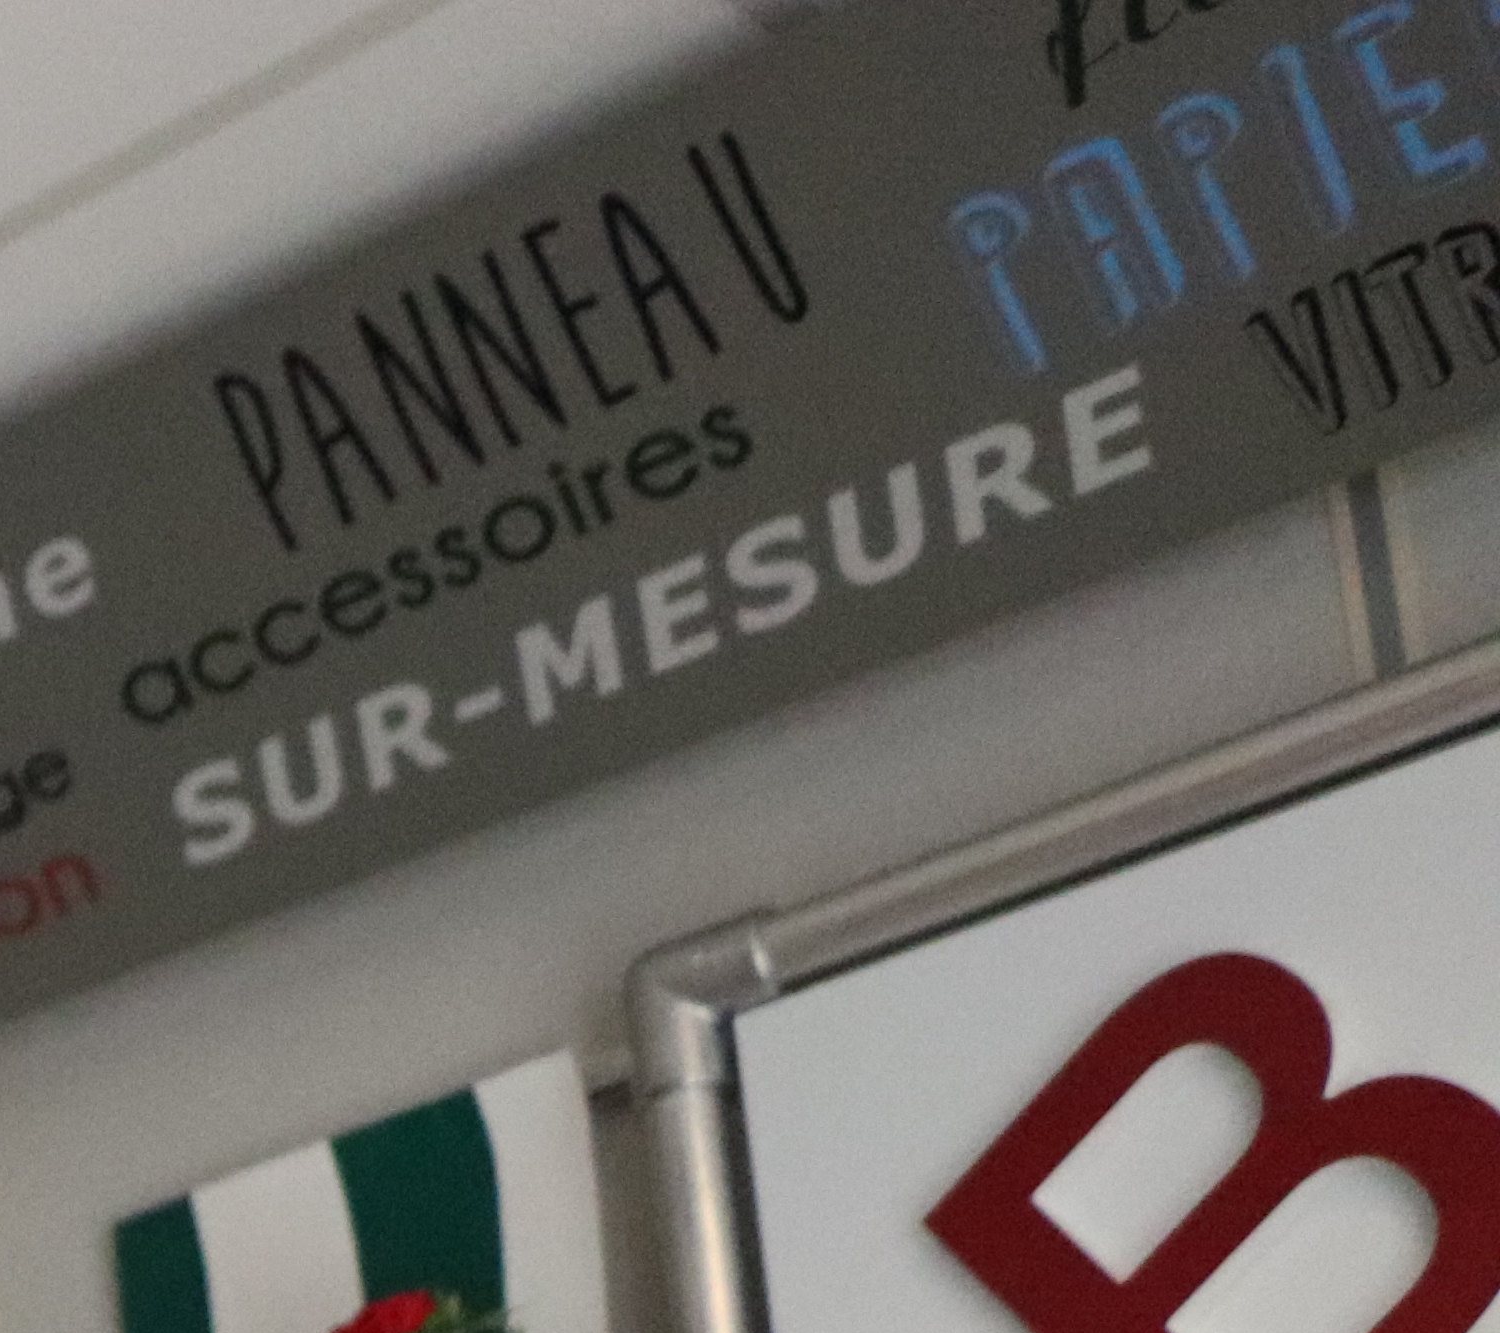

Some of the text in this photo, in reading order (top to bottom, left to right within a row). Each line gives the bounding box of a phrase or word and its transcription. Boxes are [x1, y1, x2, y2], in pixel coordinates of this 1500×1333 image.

[211, 131, 809, 553] PANNEAU
[950, 0, 1500, 374] PAPIE
[120, 403, 755, 725] accessoires
[171, 364, 1153, 867] SUR-MESURE
